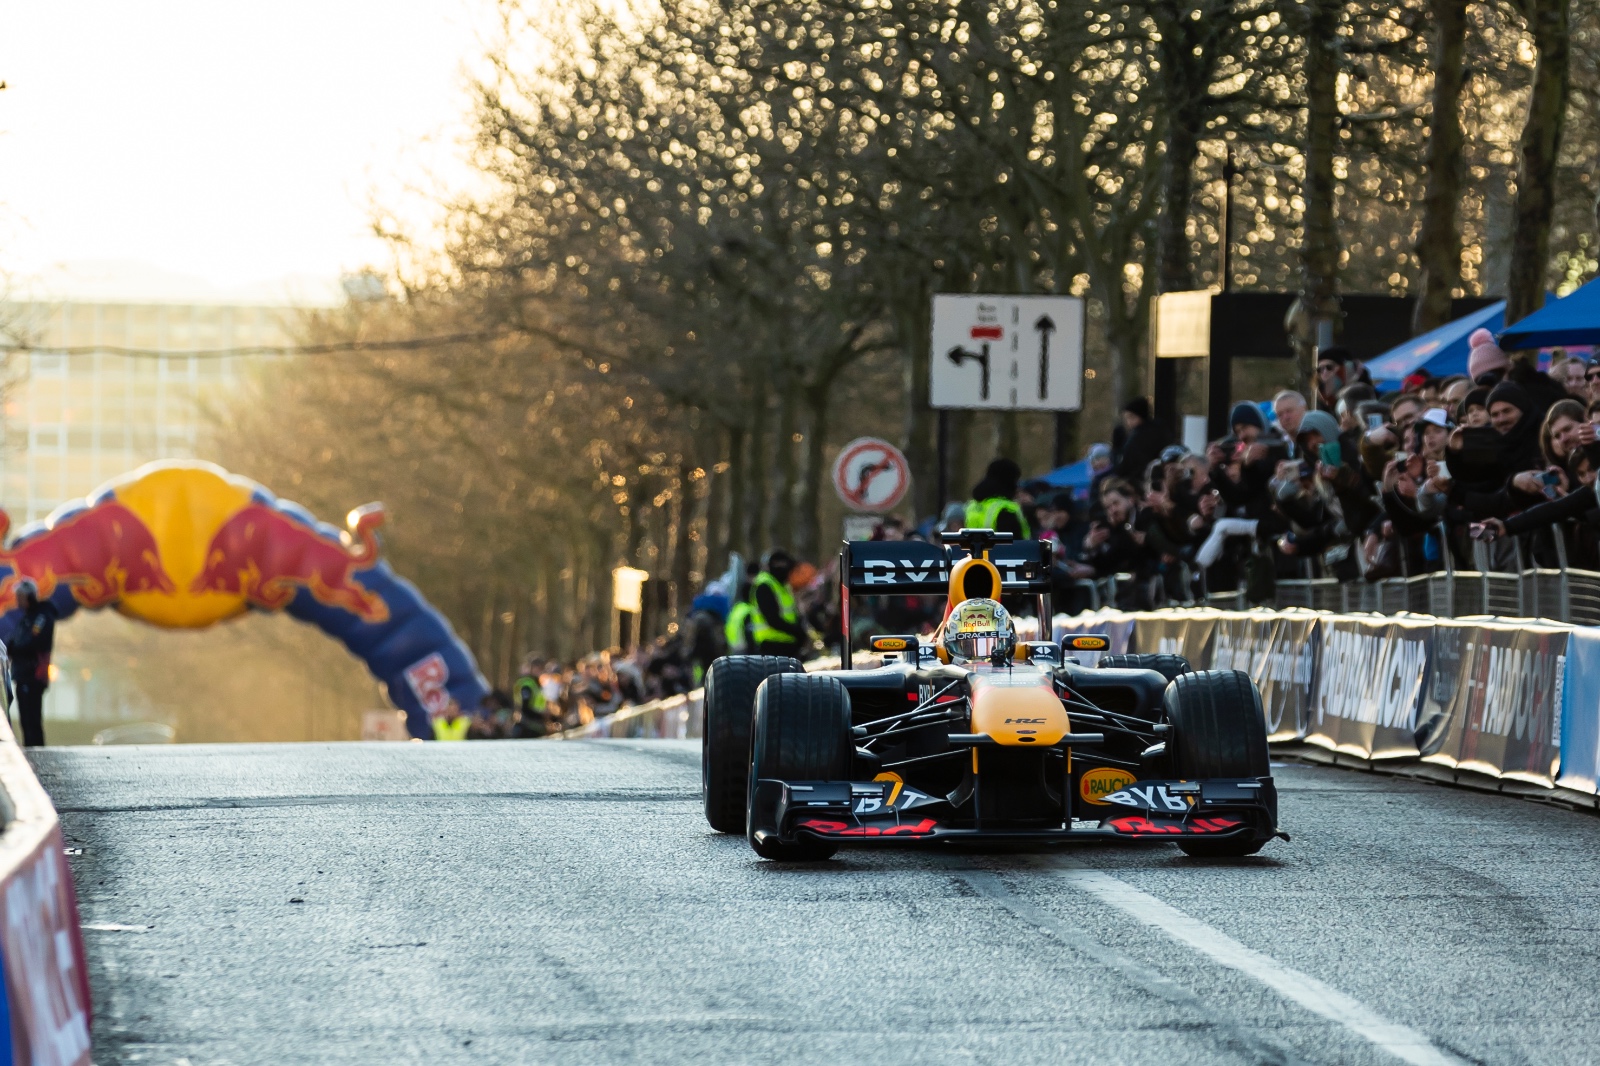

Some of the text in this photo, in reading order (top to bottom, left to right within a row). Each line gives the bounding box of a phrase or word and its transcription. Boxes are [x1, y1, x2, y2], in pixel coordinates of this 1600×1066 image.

[863, 559, 1027, 584] BYT
[956, 631, 997, 640] ORACLE
[1081, 638, 1101, 646] RAUCH
[1481, 646, 1555, 746] PADDOCK
[1090, 777, 1131, 795] RAUCH
